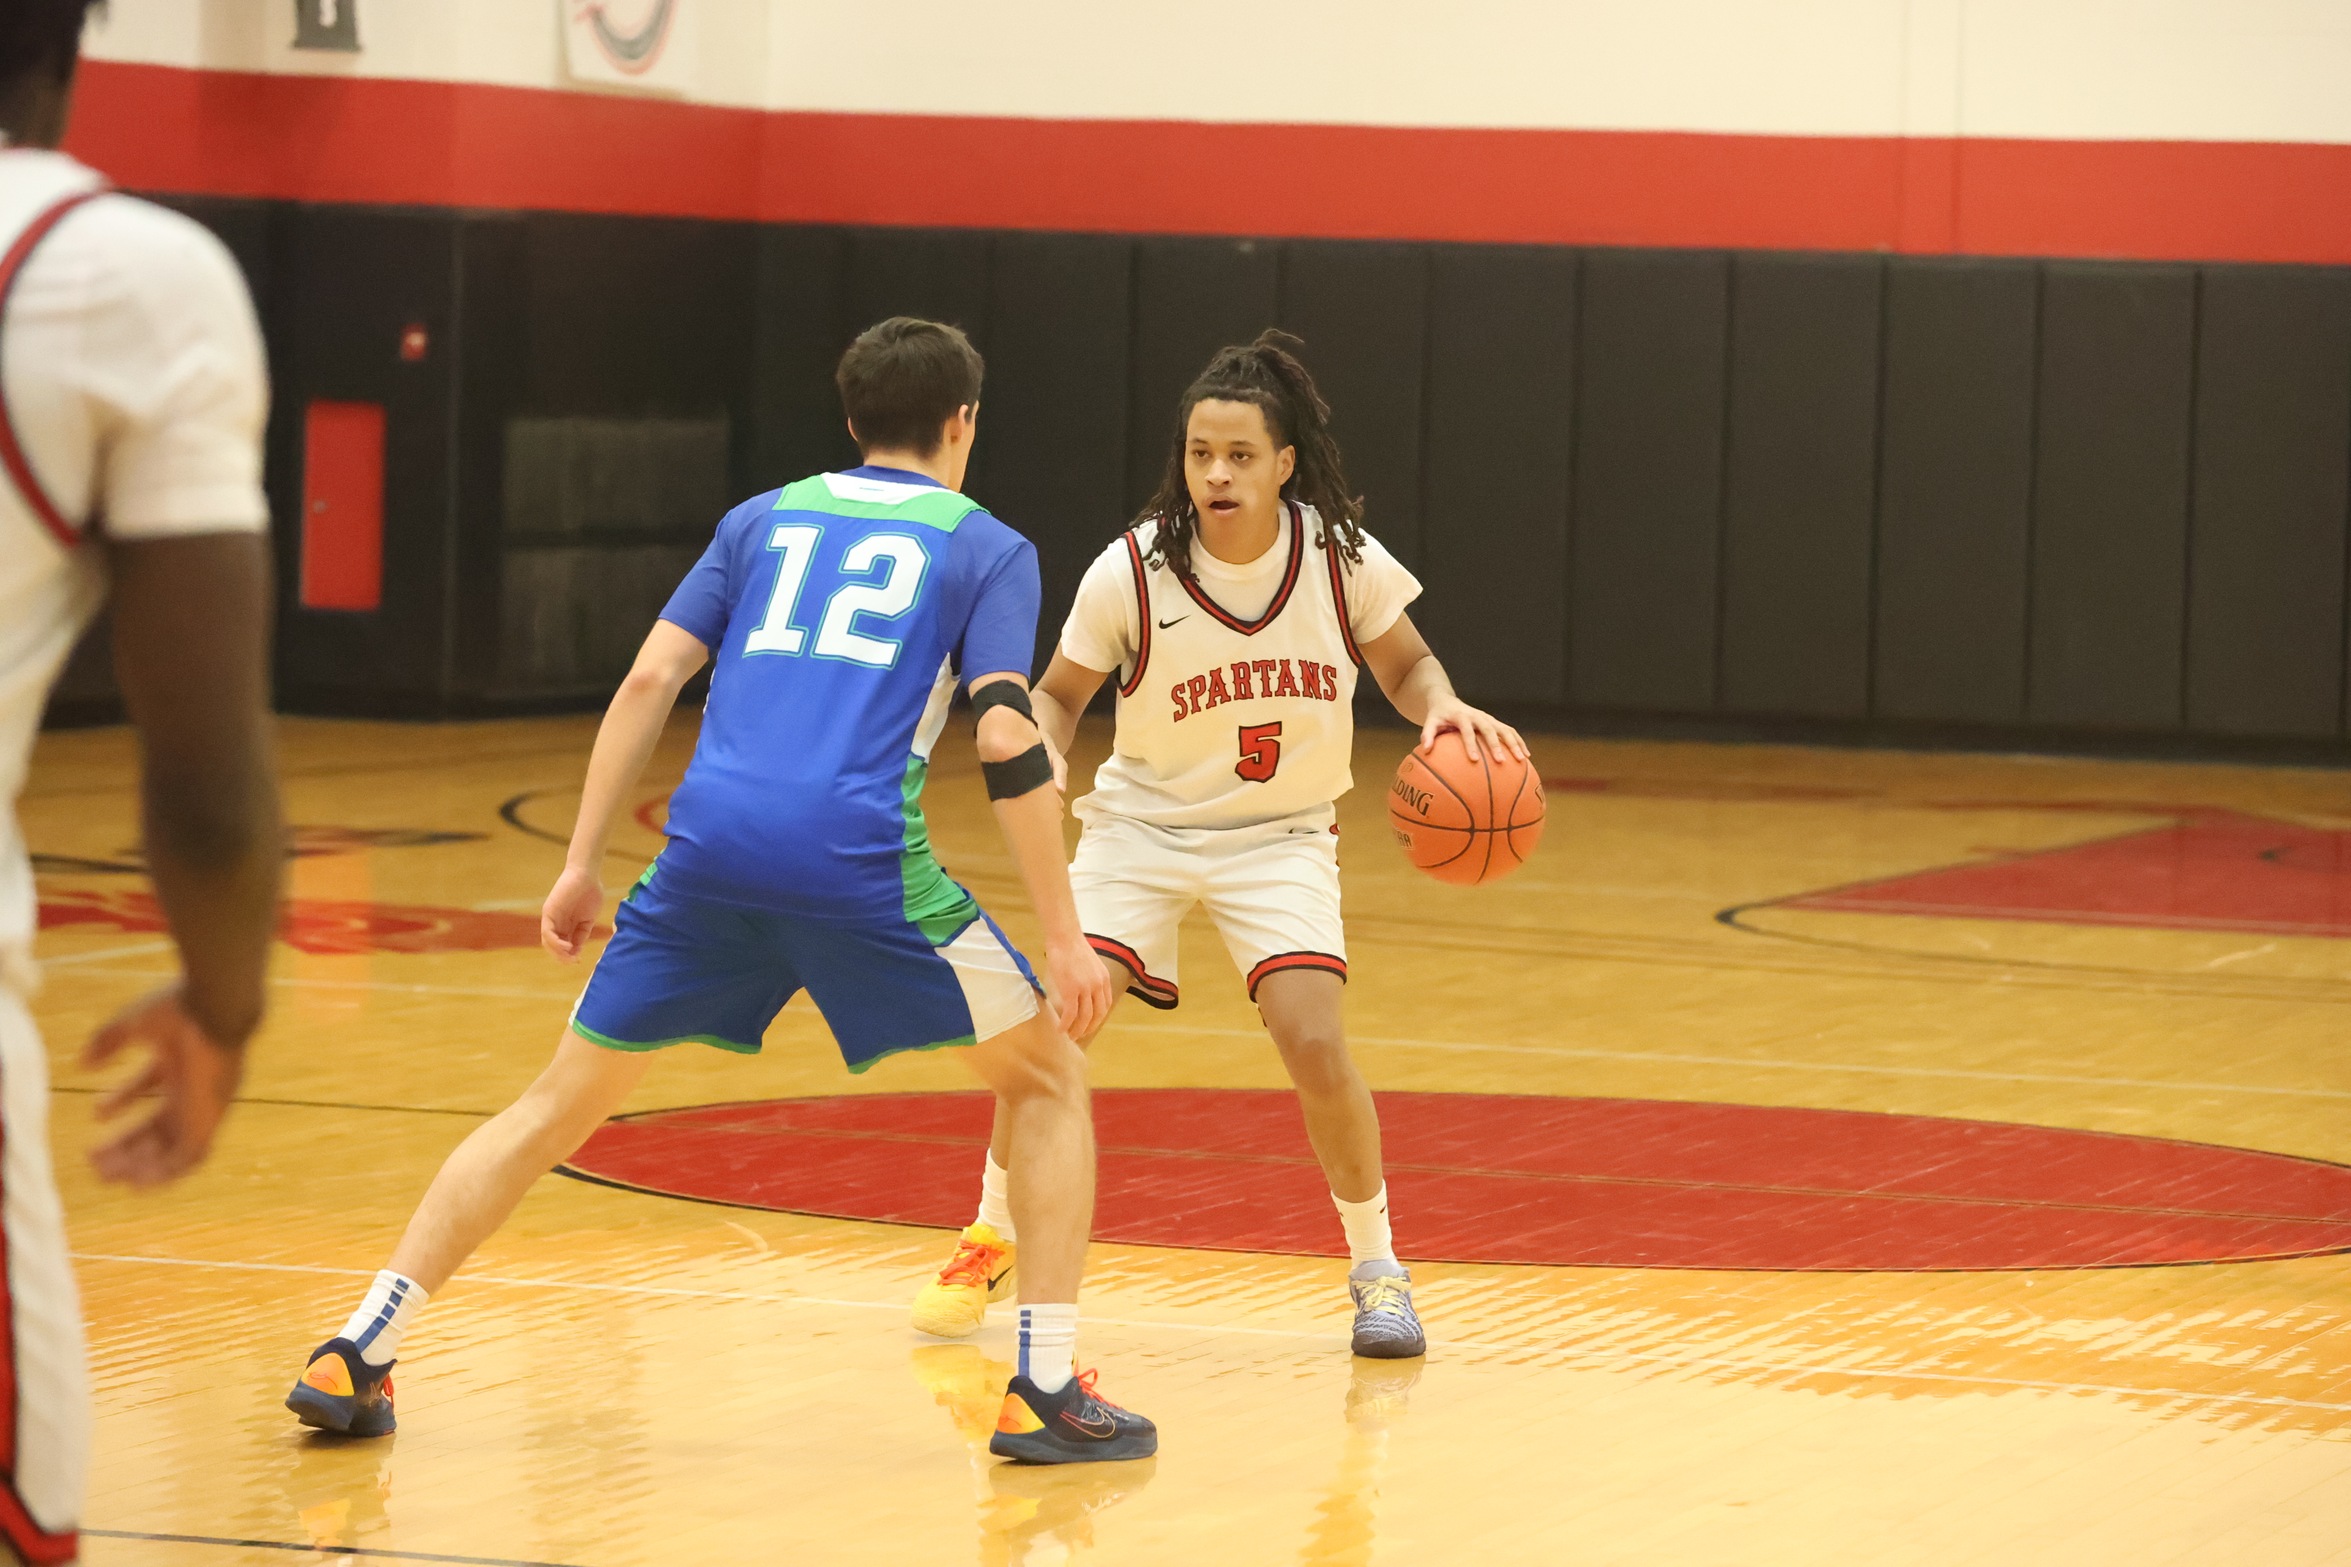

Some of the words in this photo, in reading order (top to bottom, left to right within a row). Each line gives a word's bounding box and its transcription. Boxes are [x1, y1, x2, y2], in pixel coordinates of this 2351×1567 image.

[742, 523, 931, 671] 12
[1171, 659, 1337, 723] SPARTANS
[1235, 721, 1282, 783] 5
